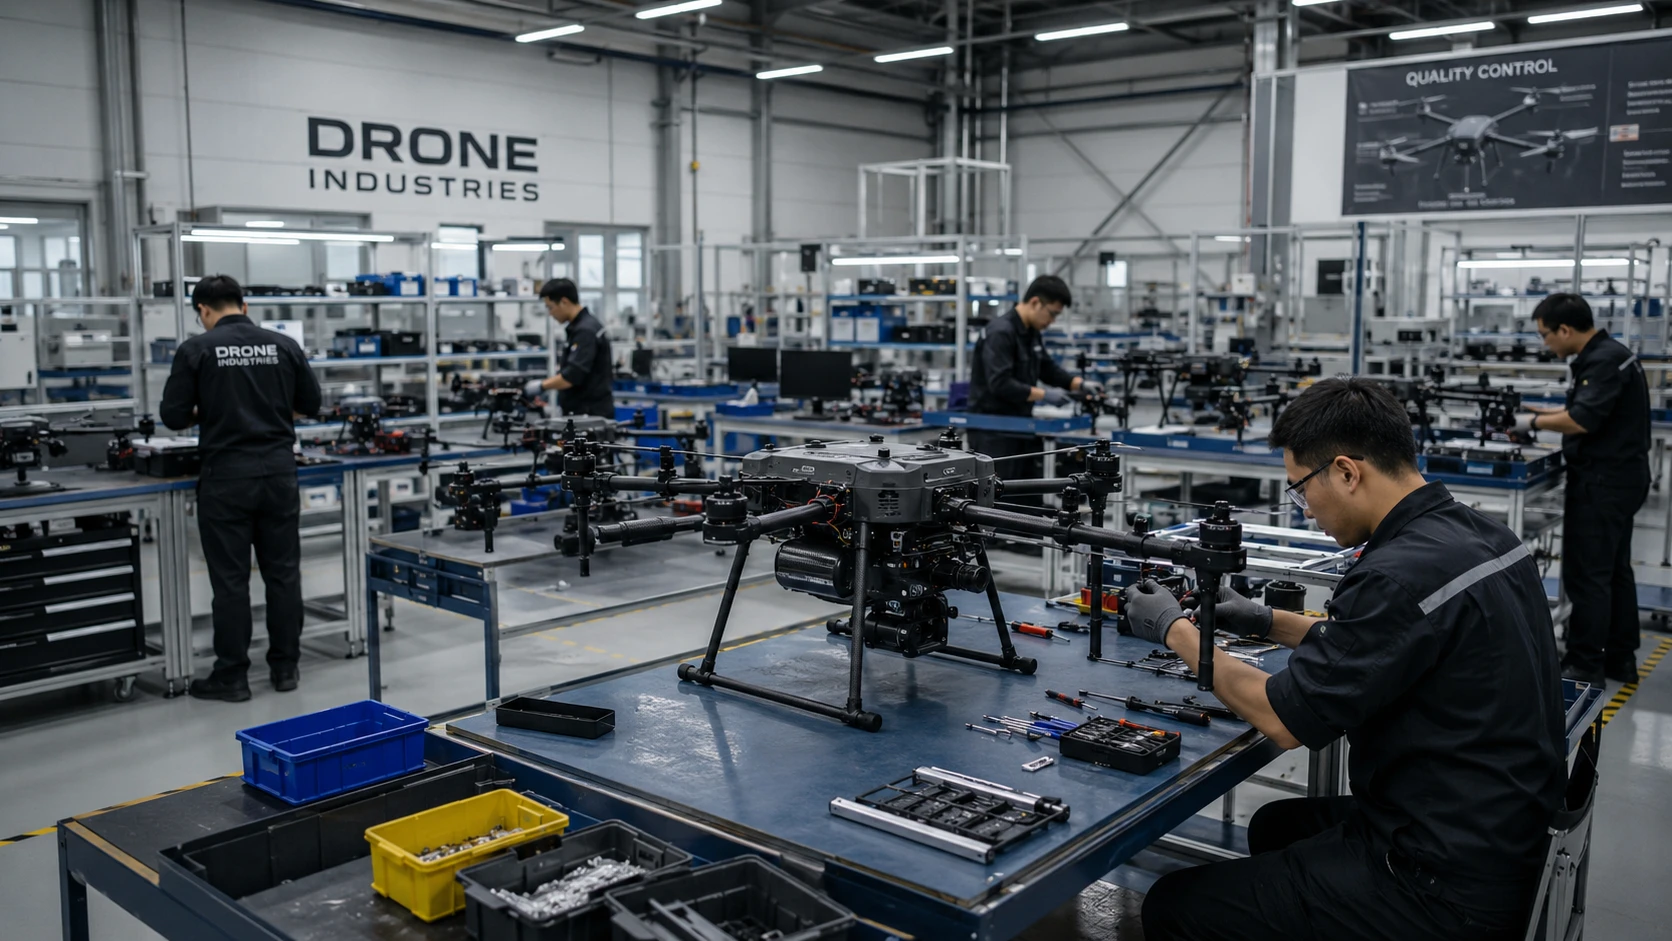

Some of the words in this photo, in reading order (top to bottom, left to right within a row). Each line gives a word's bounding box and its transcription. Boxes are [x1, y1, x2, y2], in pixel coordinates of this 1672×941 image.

[1405, 66, 1475, 88] QUALITY
[1477, 58, 1558, 79] CONTROL
[307, 117, 538, 173] DRONE
[309, 168, 540, 202] INDUSTRIES
[215, 344, 278, 359] DRONE
[217, 356, 279, 367] INDUSTRIES
